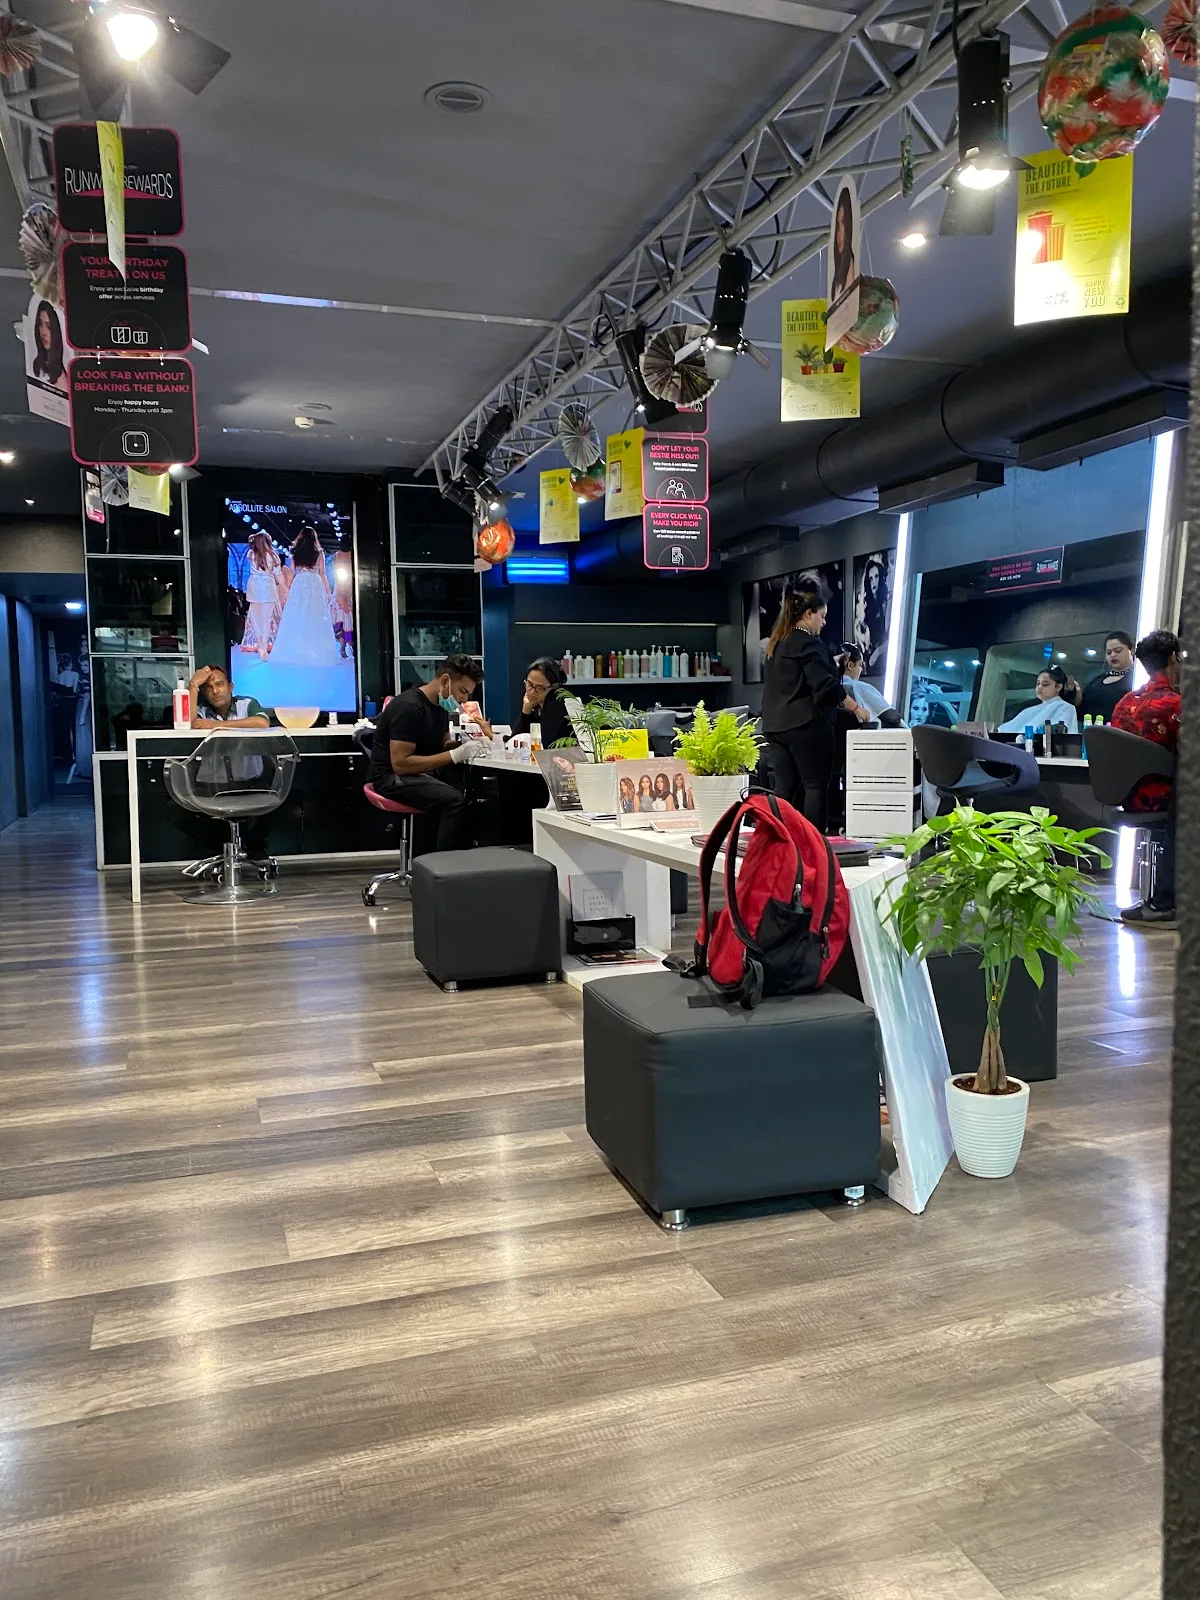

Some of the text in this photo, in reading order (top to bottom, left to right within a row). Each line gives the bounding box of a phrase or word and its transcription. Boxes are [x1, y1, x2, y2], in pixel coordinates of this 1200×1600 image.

[1026, 160, 1072, 182] BEAUTIFY
[64, 167, 103, 195] RUNW
[1026, 182, 1040, 196] THE
[1042, 176, 1071, 192] FUTURE
[80, 256, 169, 268] YOUR RTHDAY
[132, 270, 148, 280] ON
[152, 271, 166, 280] US
[1084, 288, 1105, 296] NEW
[1084, 296, 1106, 307] YOU
[786, 310, 818, 322] BEAUTIFY
[787, 322, 818, 332] THE FUTURE
[77, 370, 185, 381] LOOK FAB WITHOUT
[74, 382, 131, 392] BREAKING
[133, 383, 153, 392] THE
[156, 384, 189, 393] BANK!
[228, 504, 287, 513] ABSOLUTE SALON
